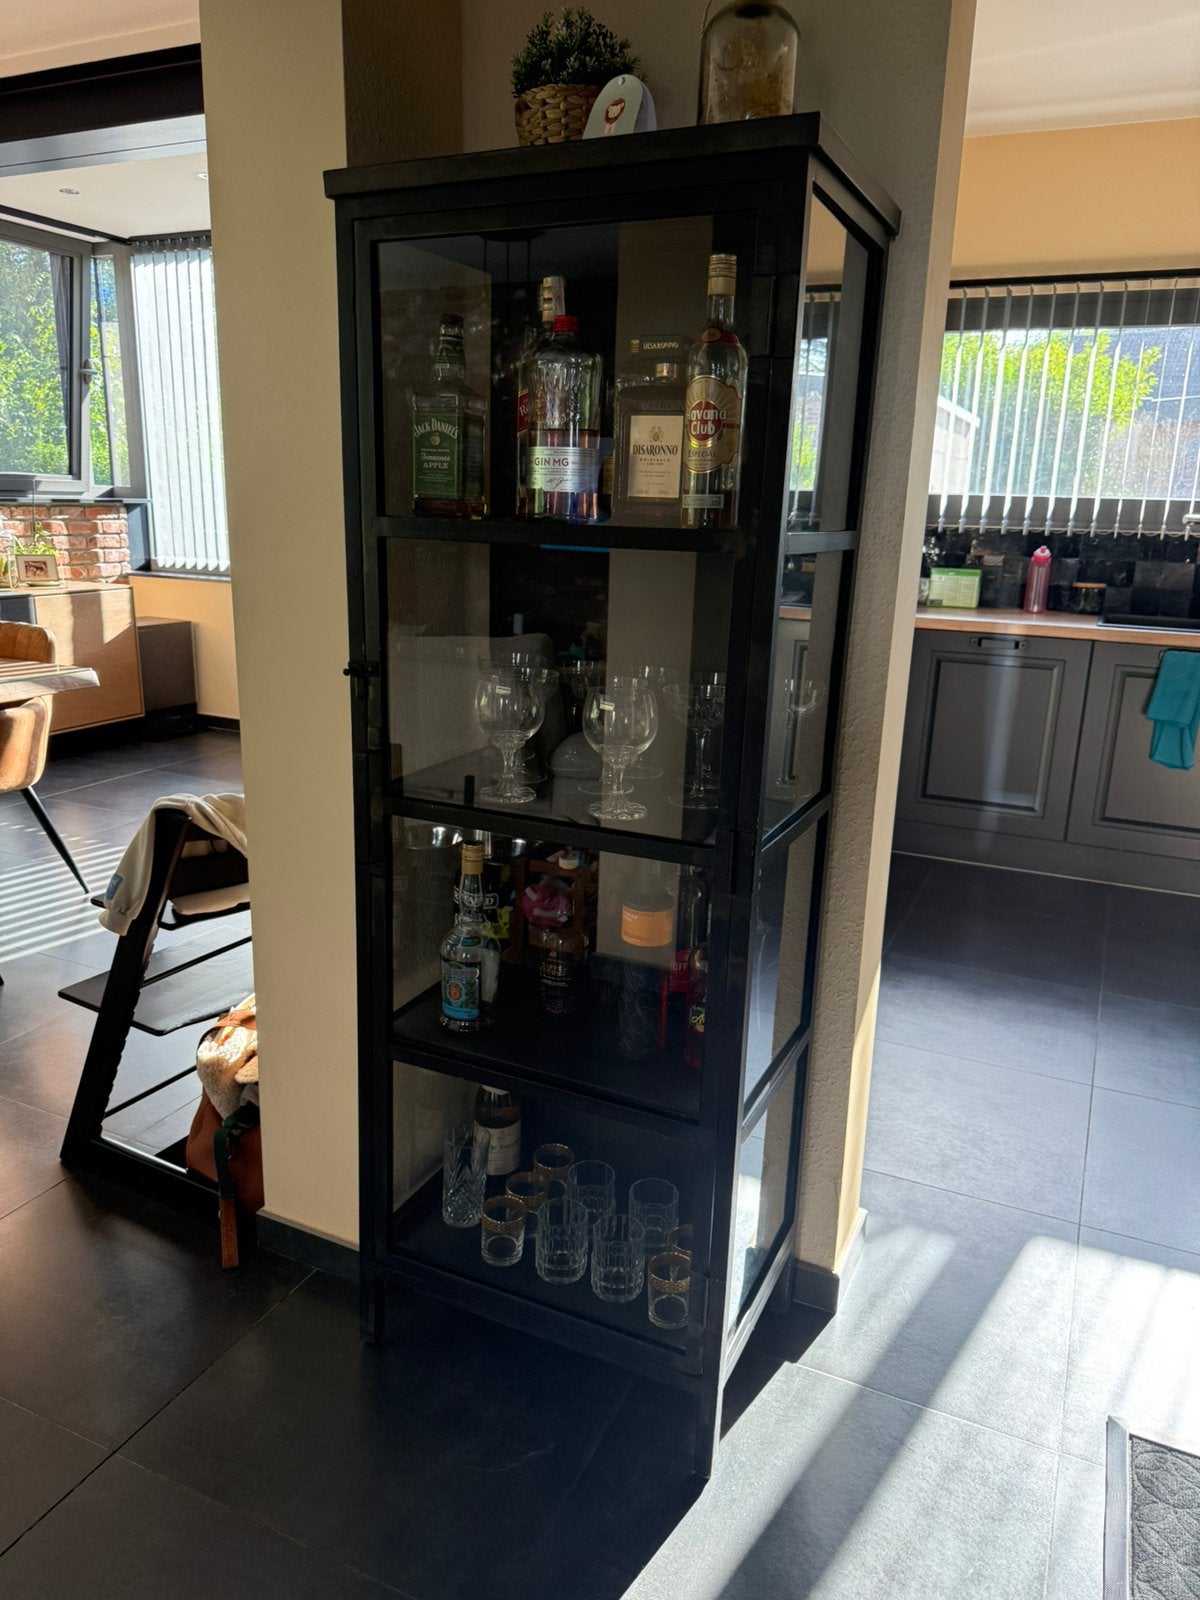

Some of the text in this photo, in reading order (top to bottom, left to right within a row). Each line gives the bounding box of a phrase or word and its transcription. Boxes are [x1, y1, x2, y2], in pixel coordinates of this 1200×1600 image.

[643, 341, 679, 350] DISARONNO
[414, 418, 458, 439] JACK DANIEL'S
[690, 421, 716, 435] Club
[632, 444, 679, 456] DISARONNO
[423, 461, 449, 469] APPLE
[534, 457, 551, 466] GIN
[553, 457, 569, 467] MG
